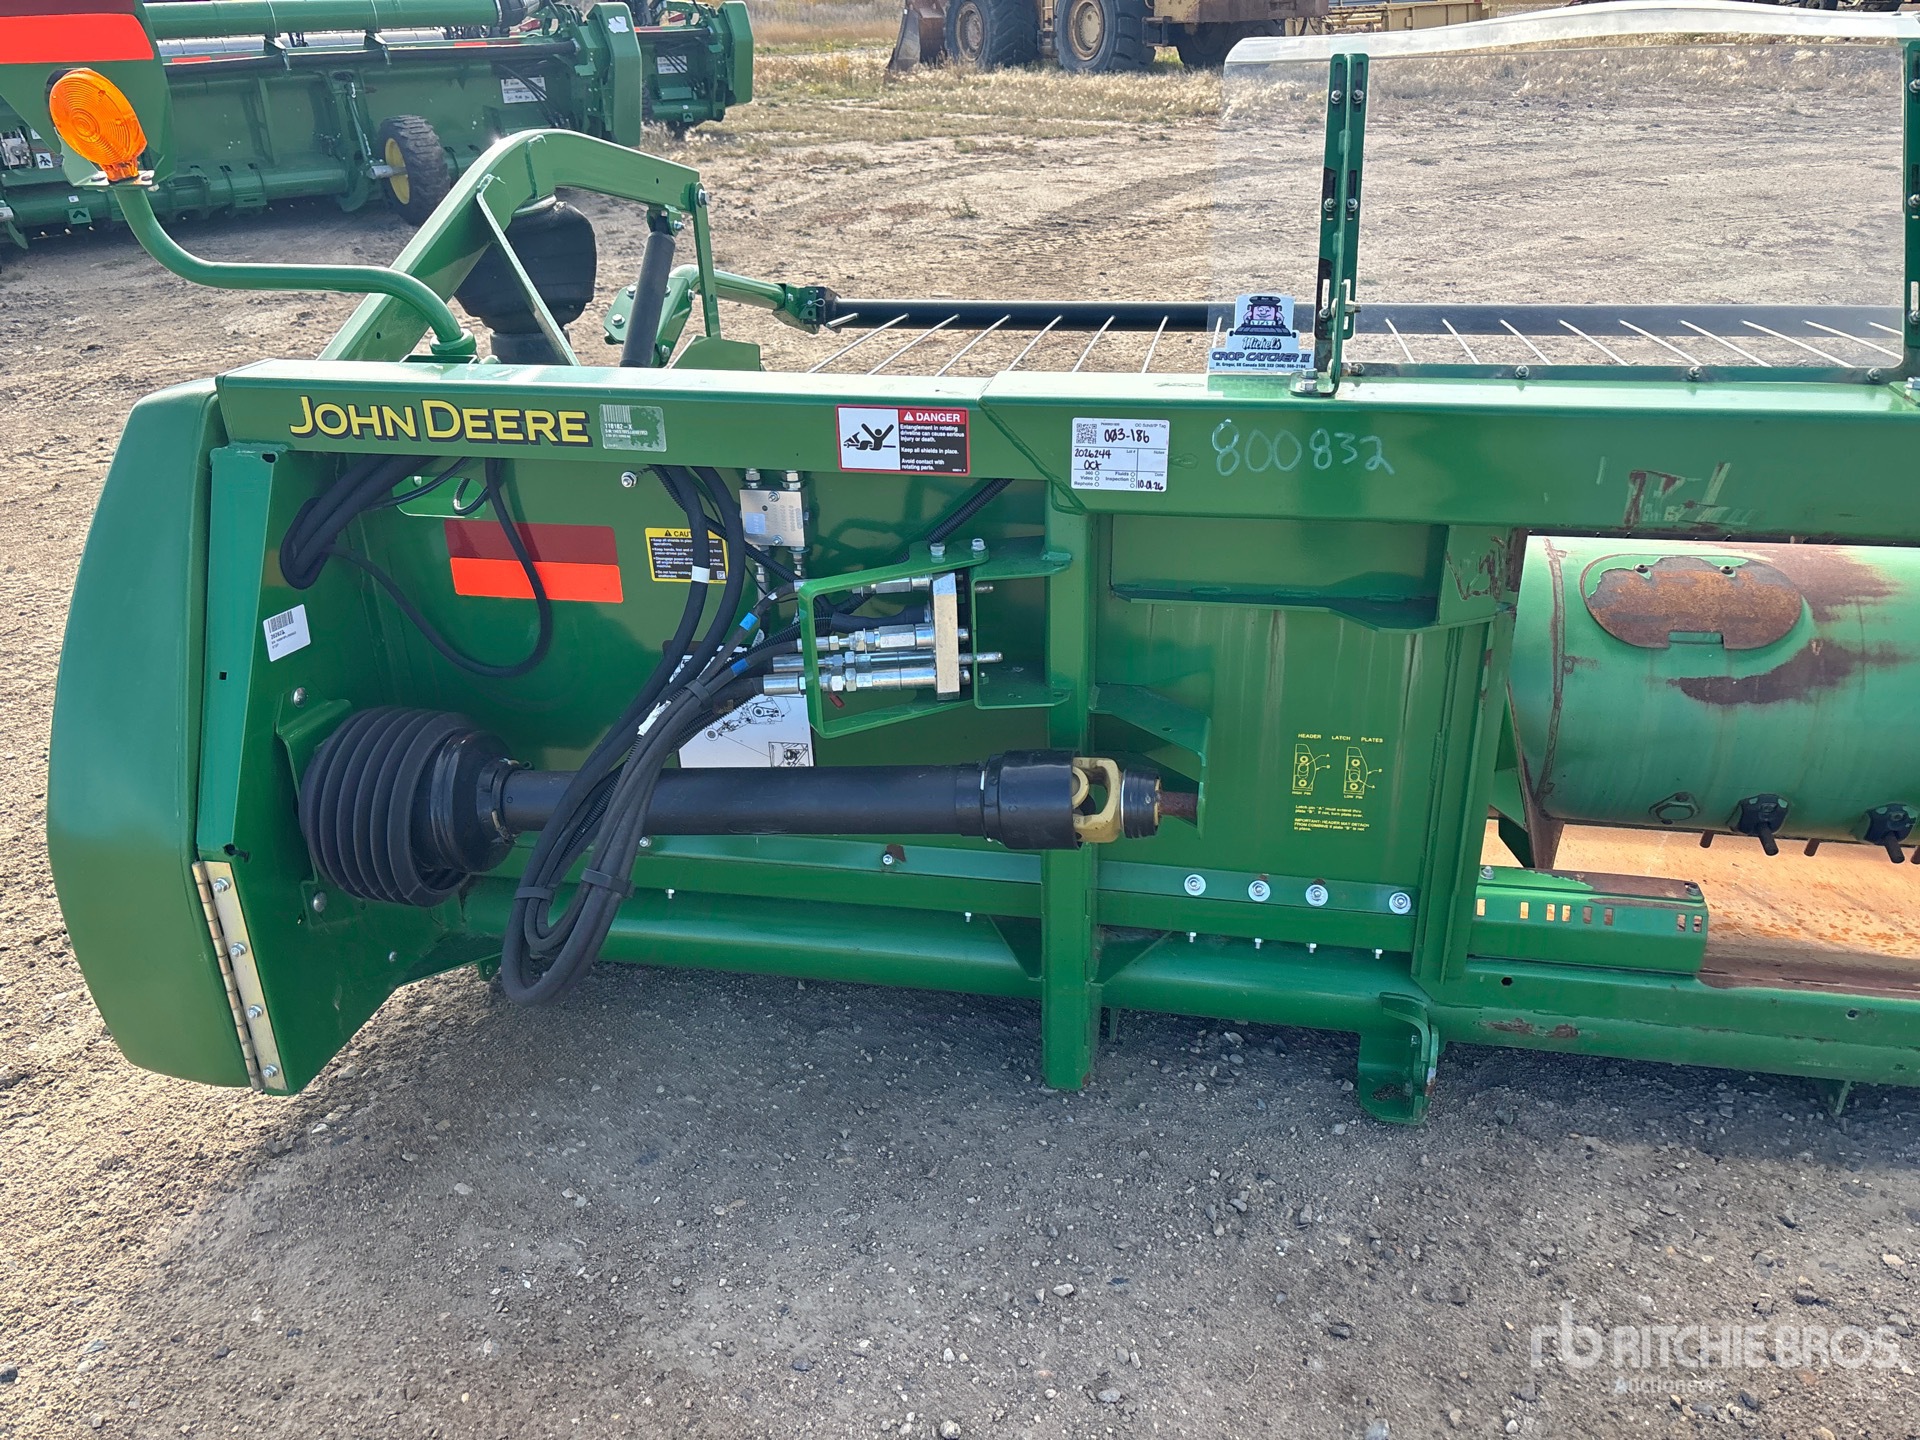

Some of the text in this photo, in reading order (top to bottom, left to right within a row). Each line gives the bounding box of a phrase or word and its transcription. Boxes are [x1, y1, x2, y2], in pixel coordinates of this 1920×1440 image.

[1242, 337, 1282, 350] Michel's
[1212, 352, 1245, 361] CROP
[1246, 352, 1299, 362] CATCHER
[290, 396, 593, 447] JOHN DEERE
[916, 412, 961, 422] DANGER
